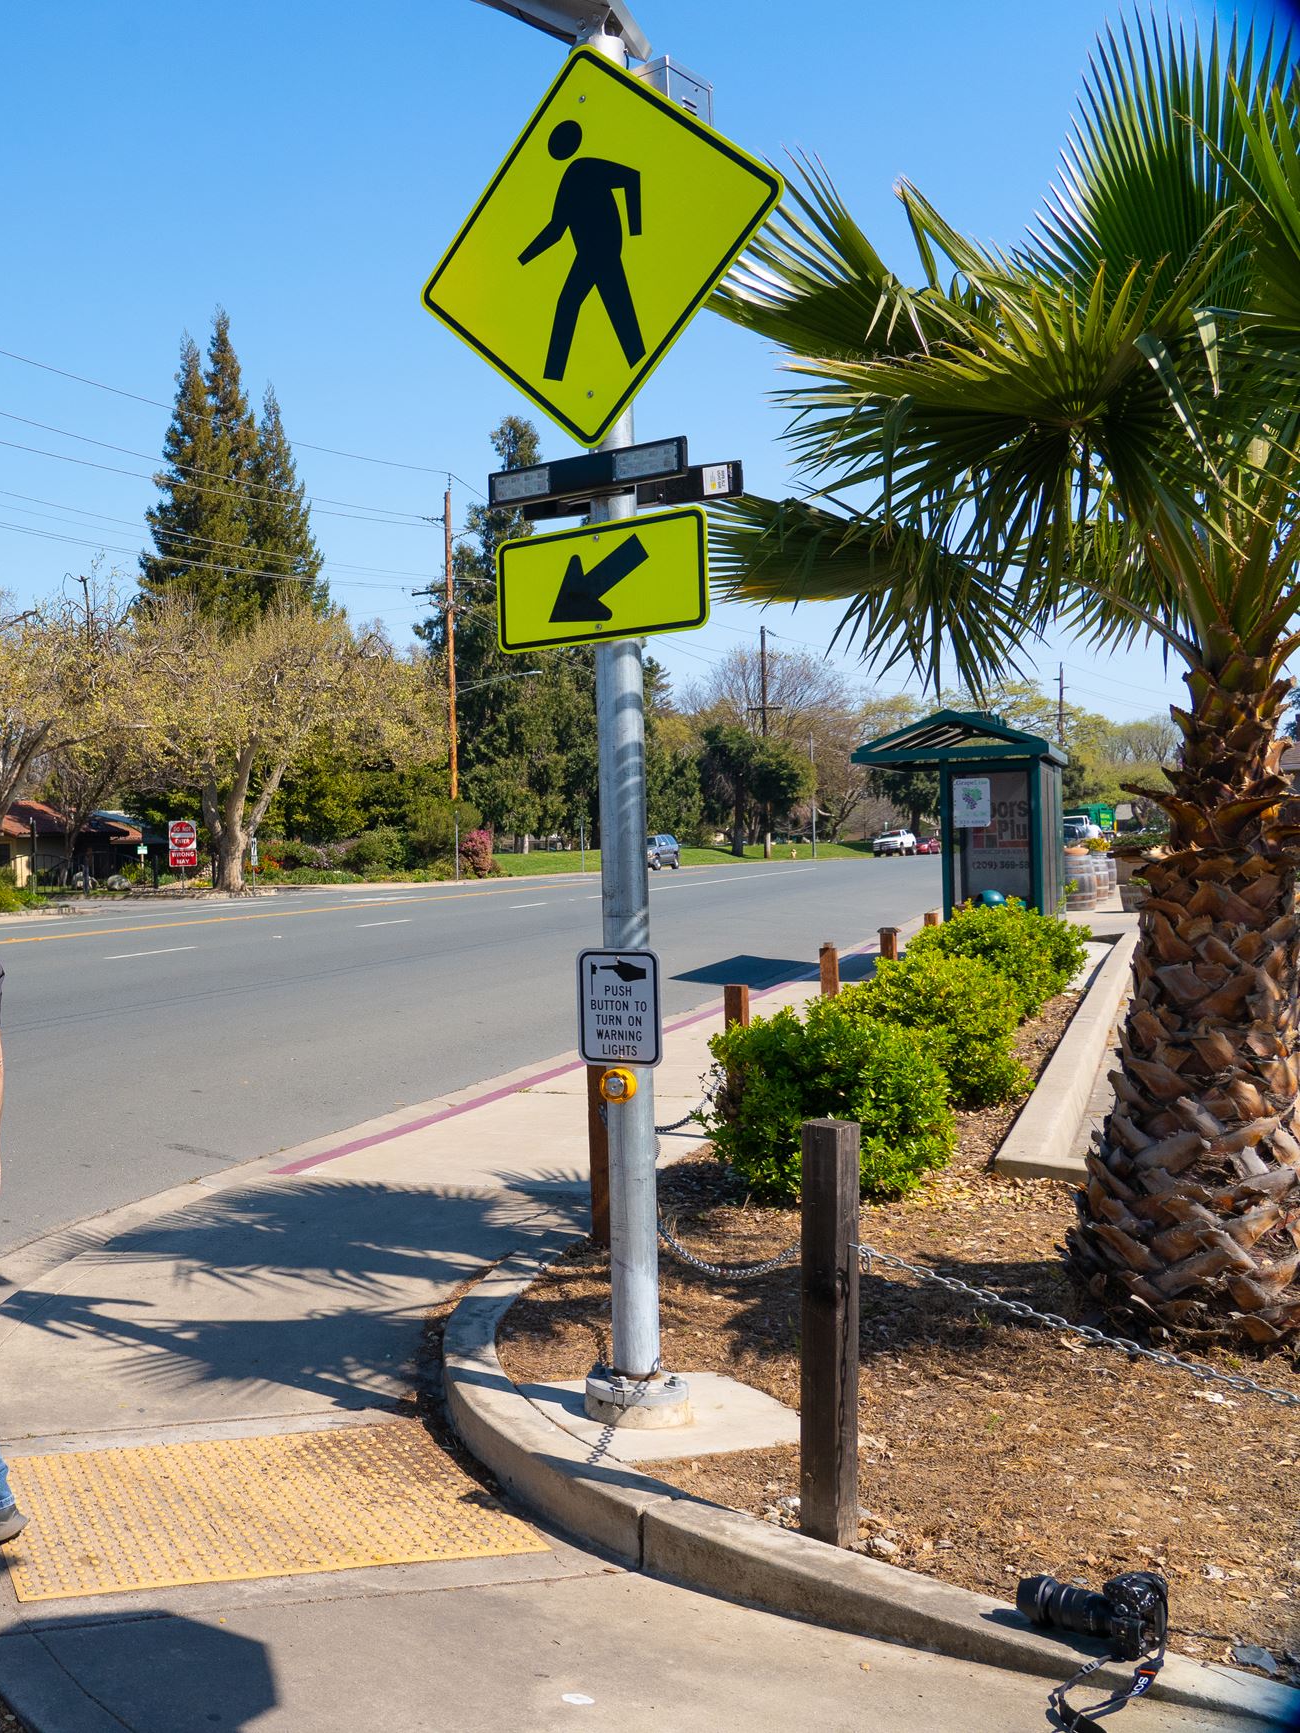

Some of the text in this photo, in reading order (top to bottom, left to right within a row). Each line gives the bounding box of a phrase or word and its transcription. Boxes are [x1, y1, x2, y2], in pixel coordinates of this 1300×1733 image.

[972, 860, 998, 870] (209)
[604, 985, 632, 997] PUSH
[590, 999, 647, 1012] BUTTON TO
[596, 1014, 642, 1027] TURN ON
[596, 1029, 642, 1041] WARNING
[602, 1044, 638, 1056] LIGHTS
